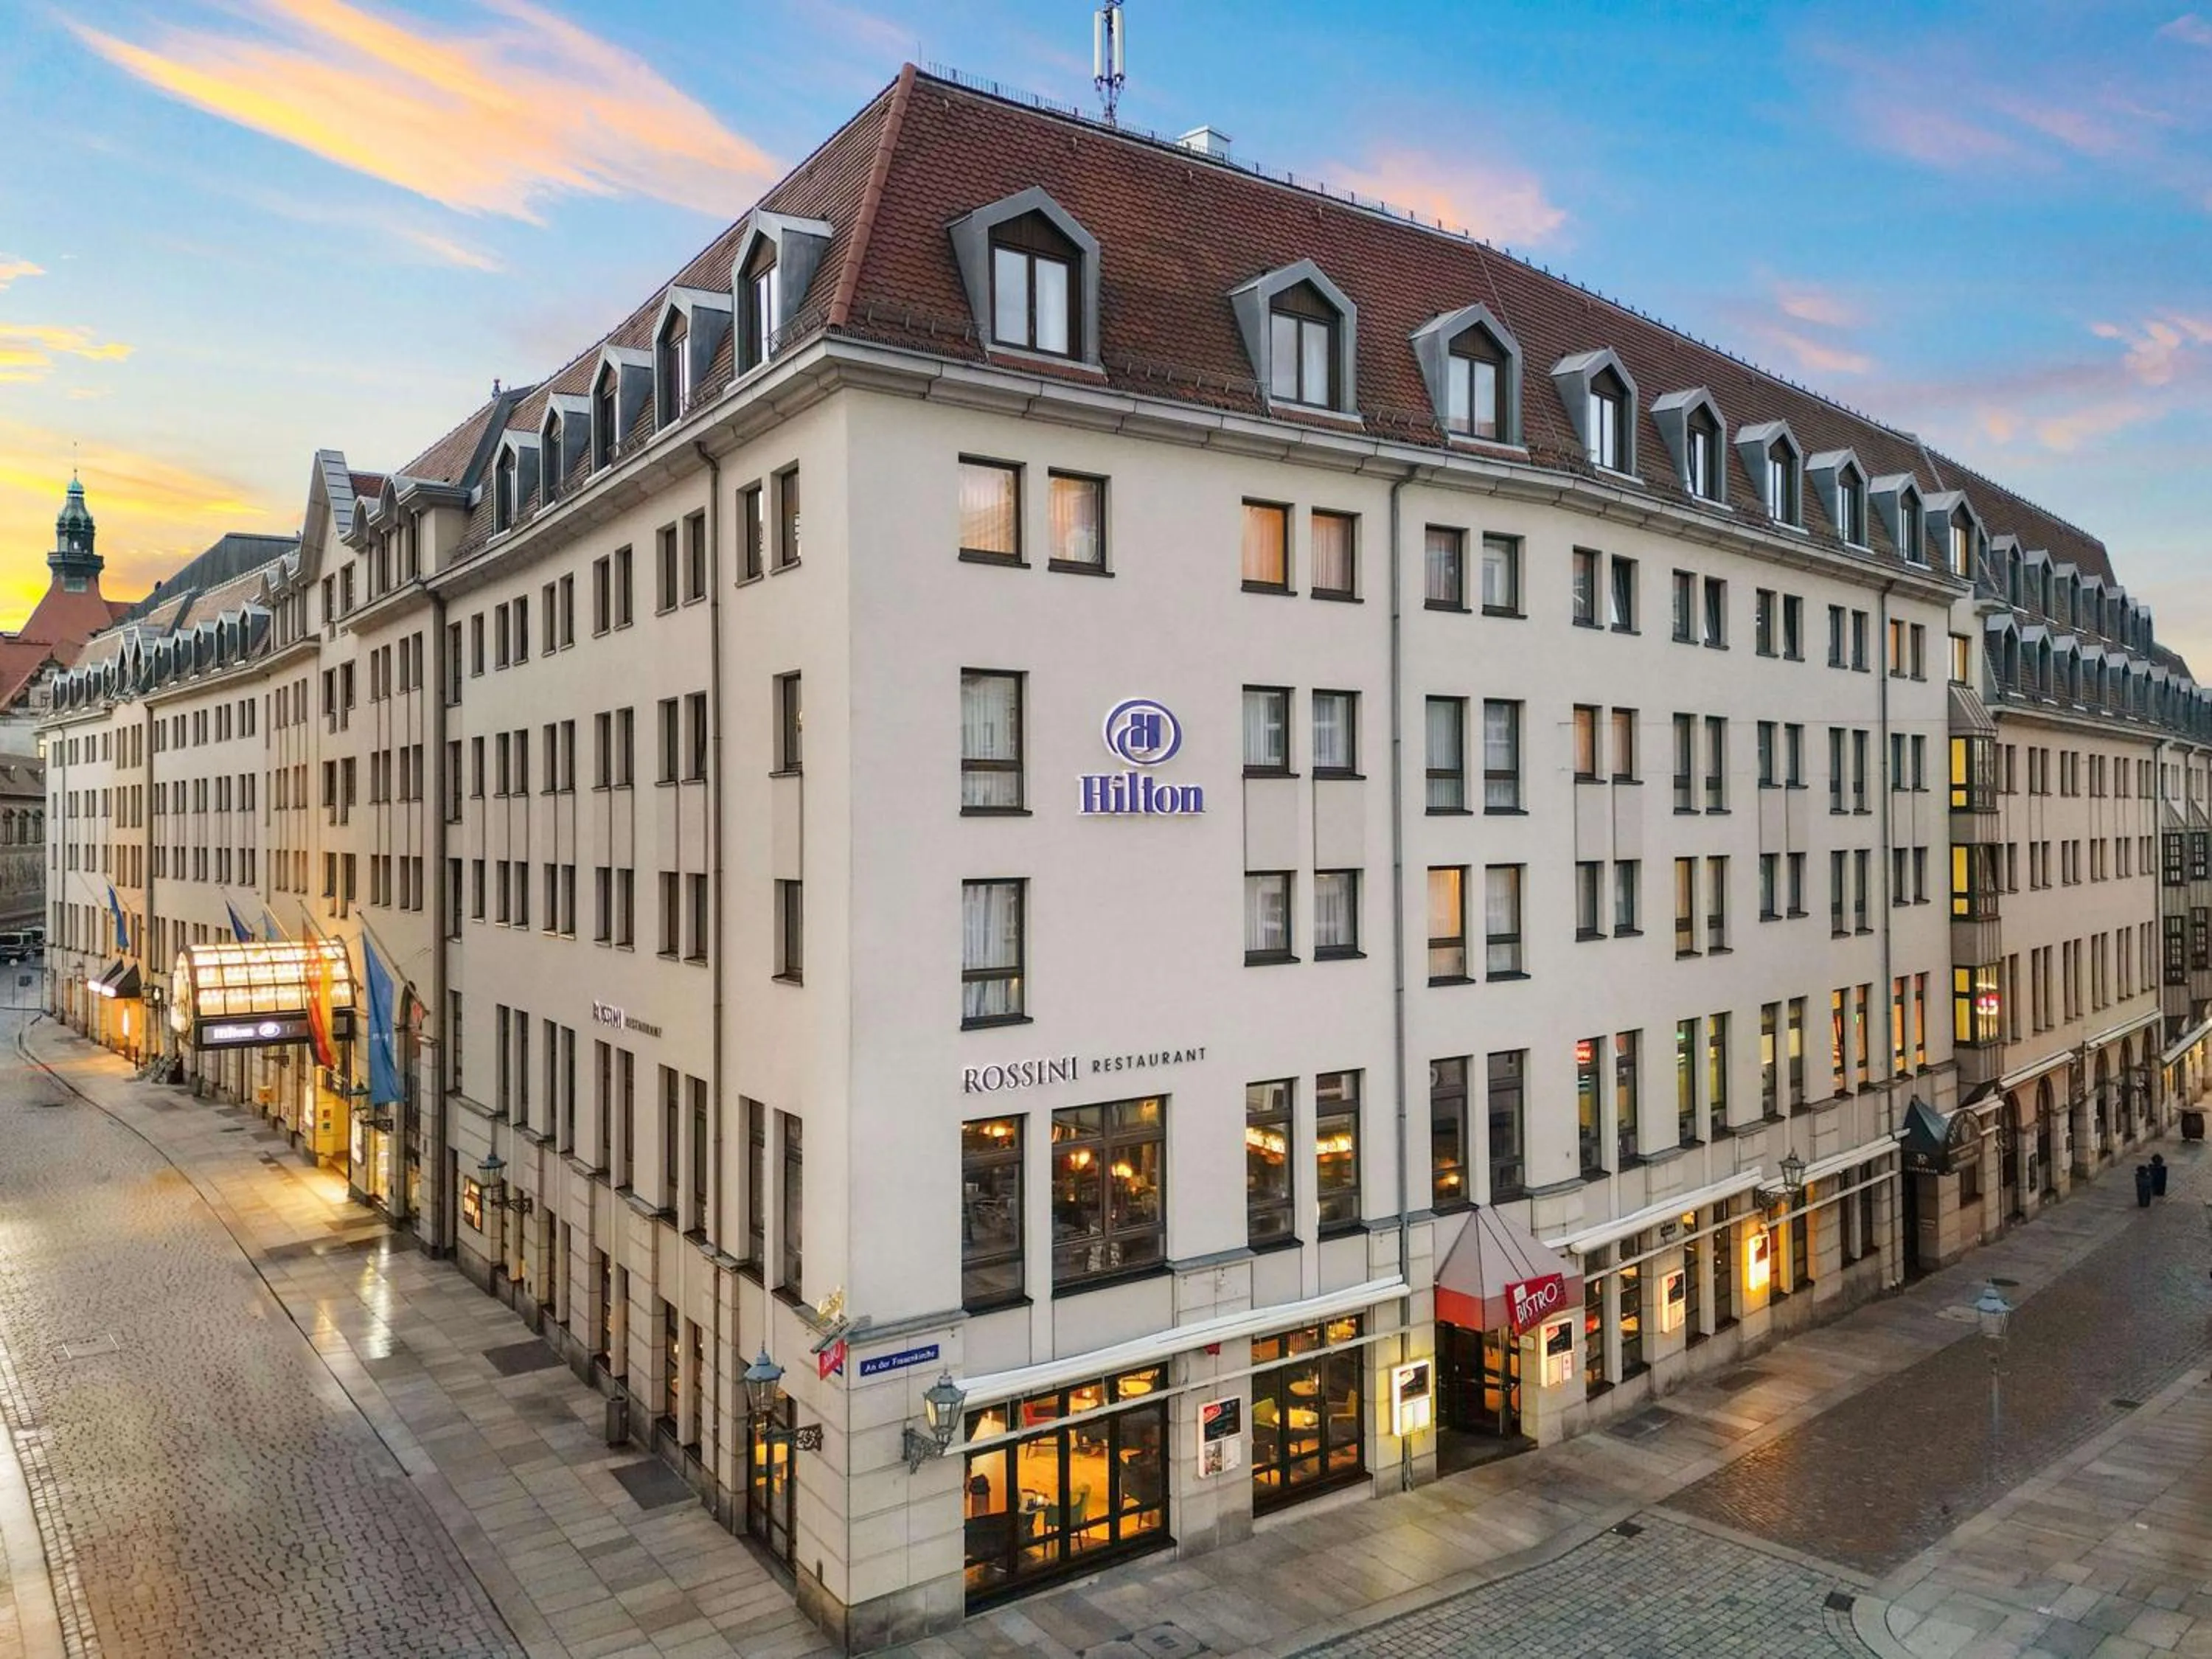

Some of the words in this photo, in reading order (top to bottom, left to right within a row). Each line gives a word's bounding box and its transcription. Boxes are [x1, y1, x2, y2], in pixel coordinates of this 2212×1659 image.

[1079, 771, 1206, 814] Hilton
[964, 1057, 1079, 1093] ROSSINI
[1092, 1047, 1206, 1074] RESTAURANT
[1516, 1282, 1558, 1325] BISTRO
